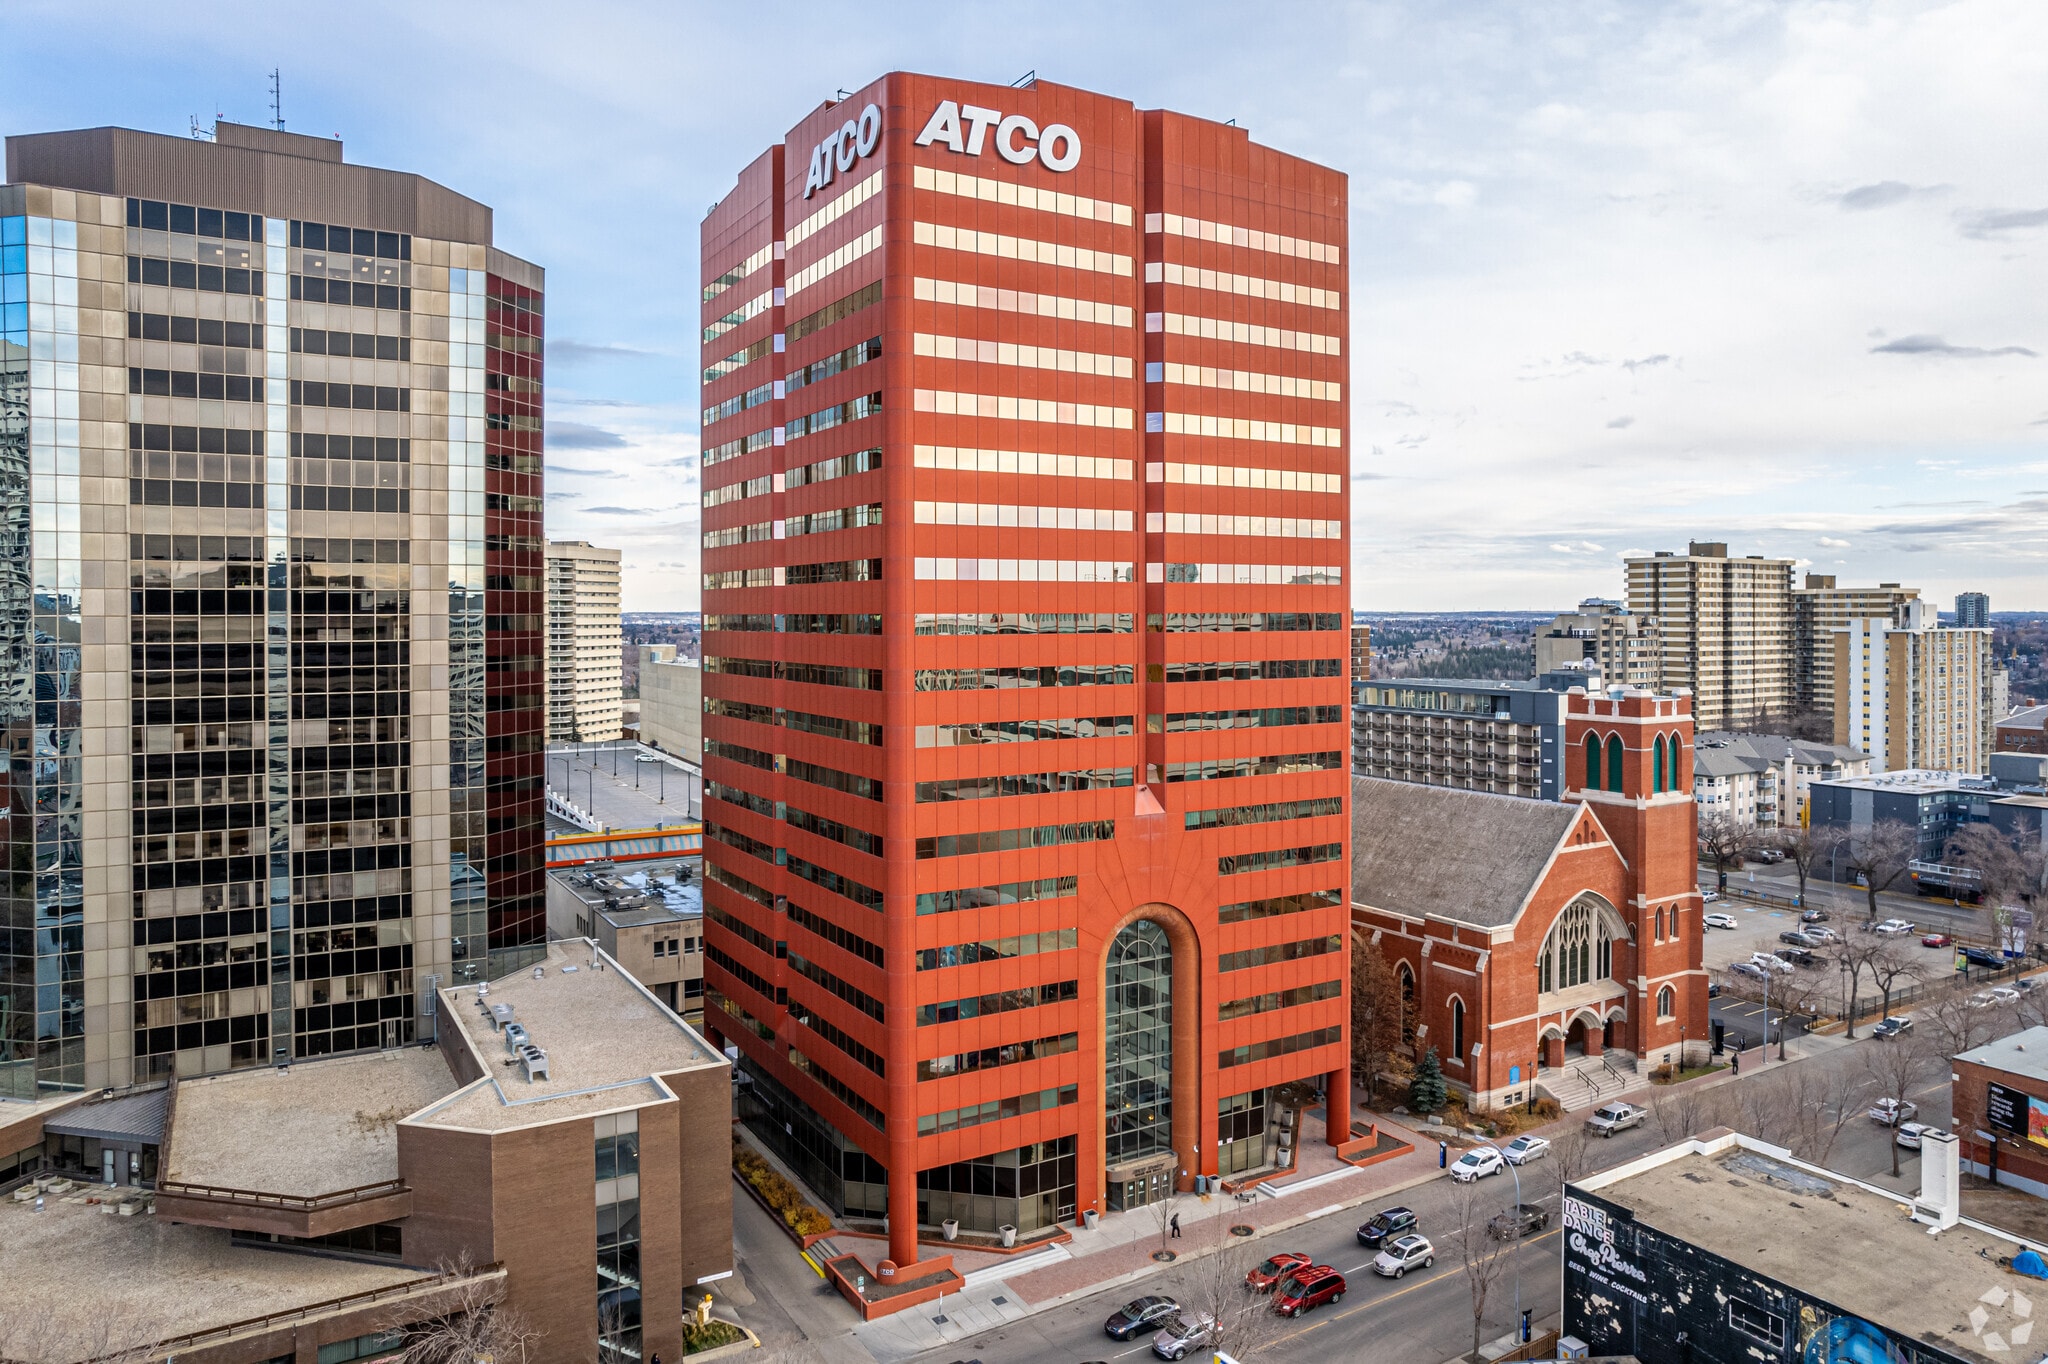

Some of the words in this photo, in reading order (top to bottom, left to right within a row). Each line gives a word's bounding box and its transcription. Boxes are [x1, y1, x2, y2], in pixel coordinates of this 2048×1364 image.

[803, 103, 882, 200] ATCO
[914, 100, 1082, 172] ATCO
[1564, 1199, 1604, 1225] TABLE
[1564, 1214, 1611, 1244] DANCE
[1569, 1232, 1601, 1266] Chez
[1588, 1270, 1608, 1285] WINE
[1611, 1281, 1648, 1304] COCKTAILS
